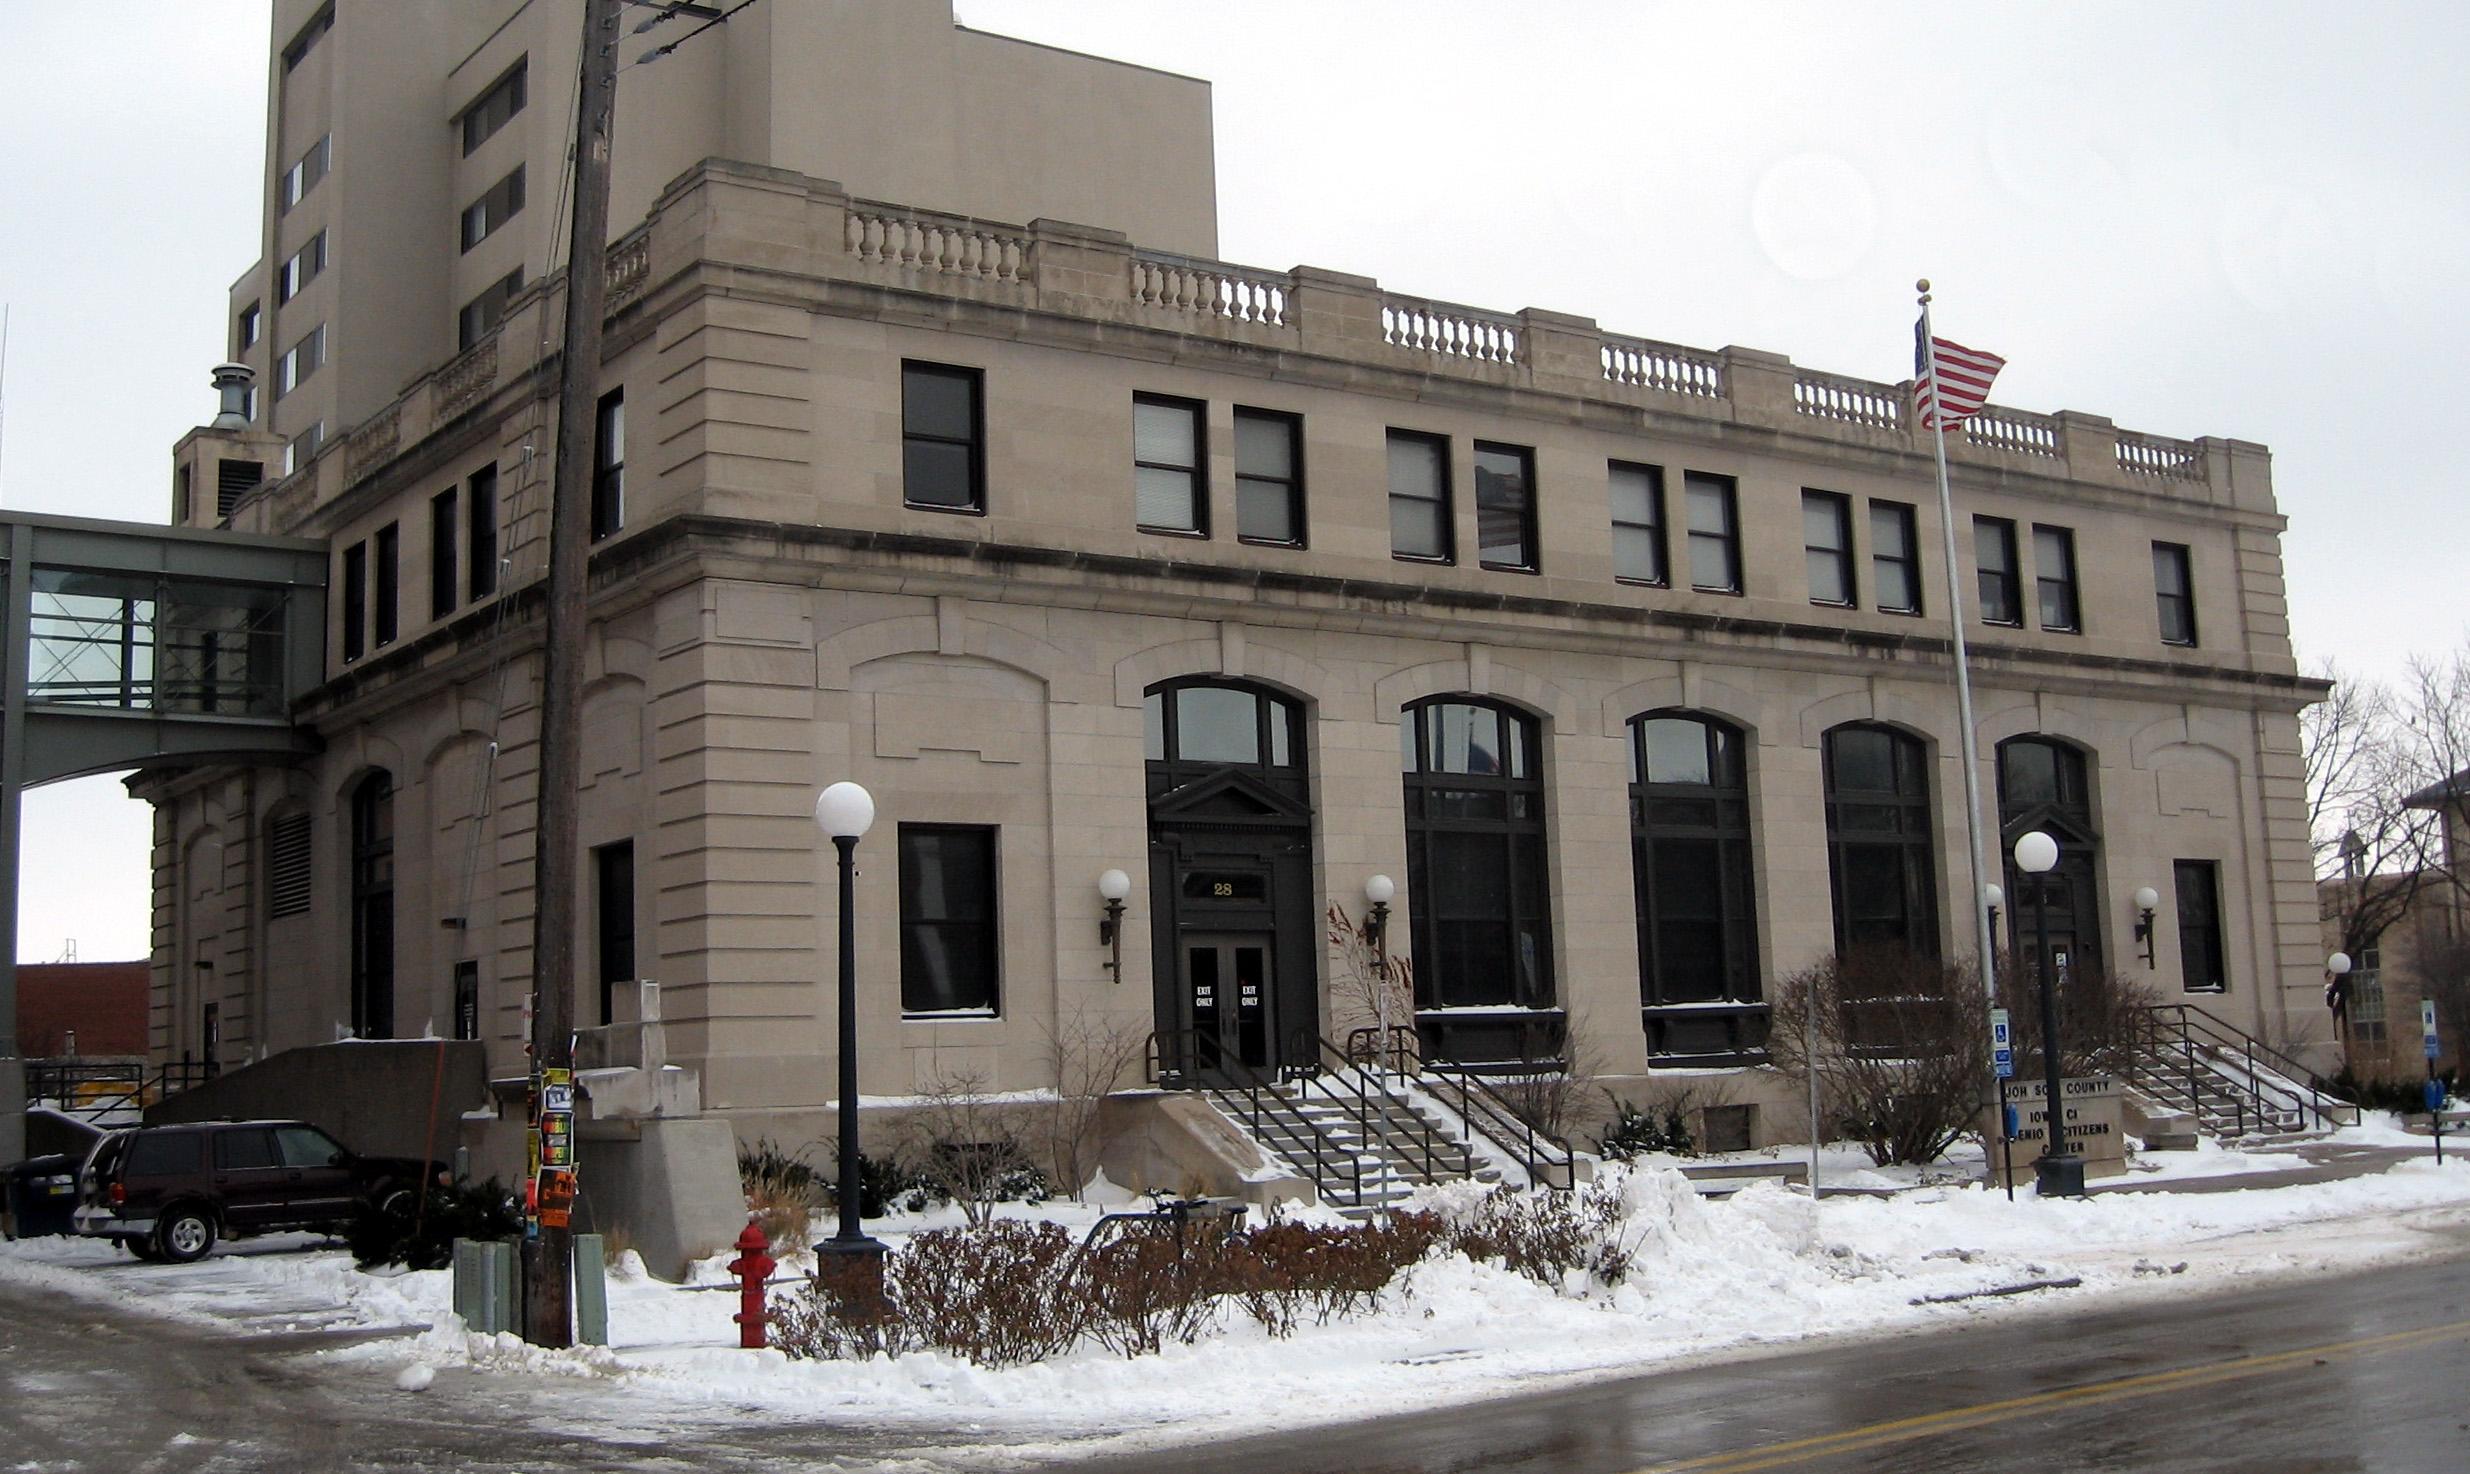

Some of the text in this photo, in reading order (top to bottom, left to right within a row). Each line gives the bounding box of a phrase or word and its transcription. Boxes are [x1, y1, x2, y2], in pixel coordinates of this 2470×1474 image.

[1214, 883, 1232, 896] 28
[1197, 986, 1211, 995] EXIT
[1243, 985, 1256, 995] EXIT
[1196, 997, 1213, 1007] ONLY
[1241, 997, 1258, 1006] ONLY
[2066, 1081, 2109, 1094] COUNTY
